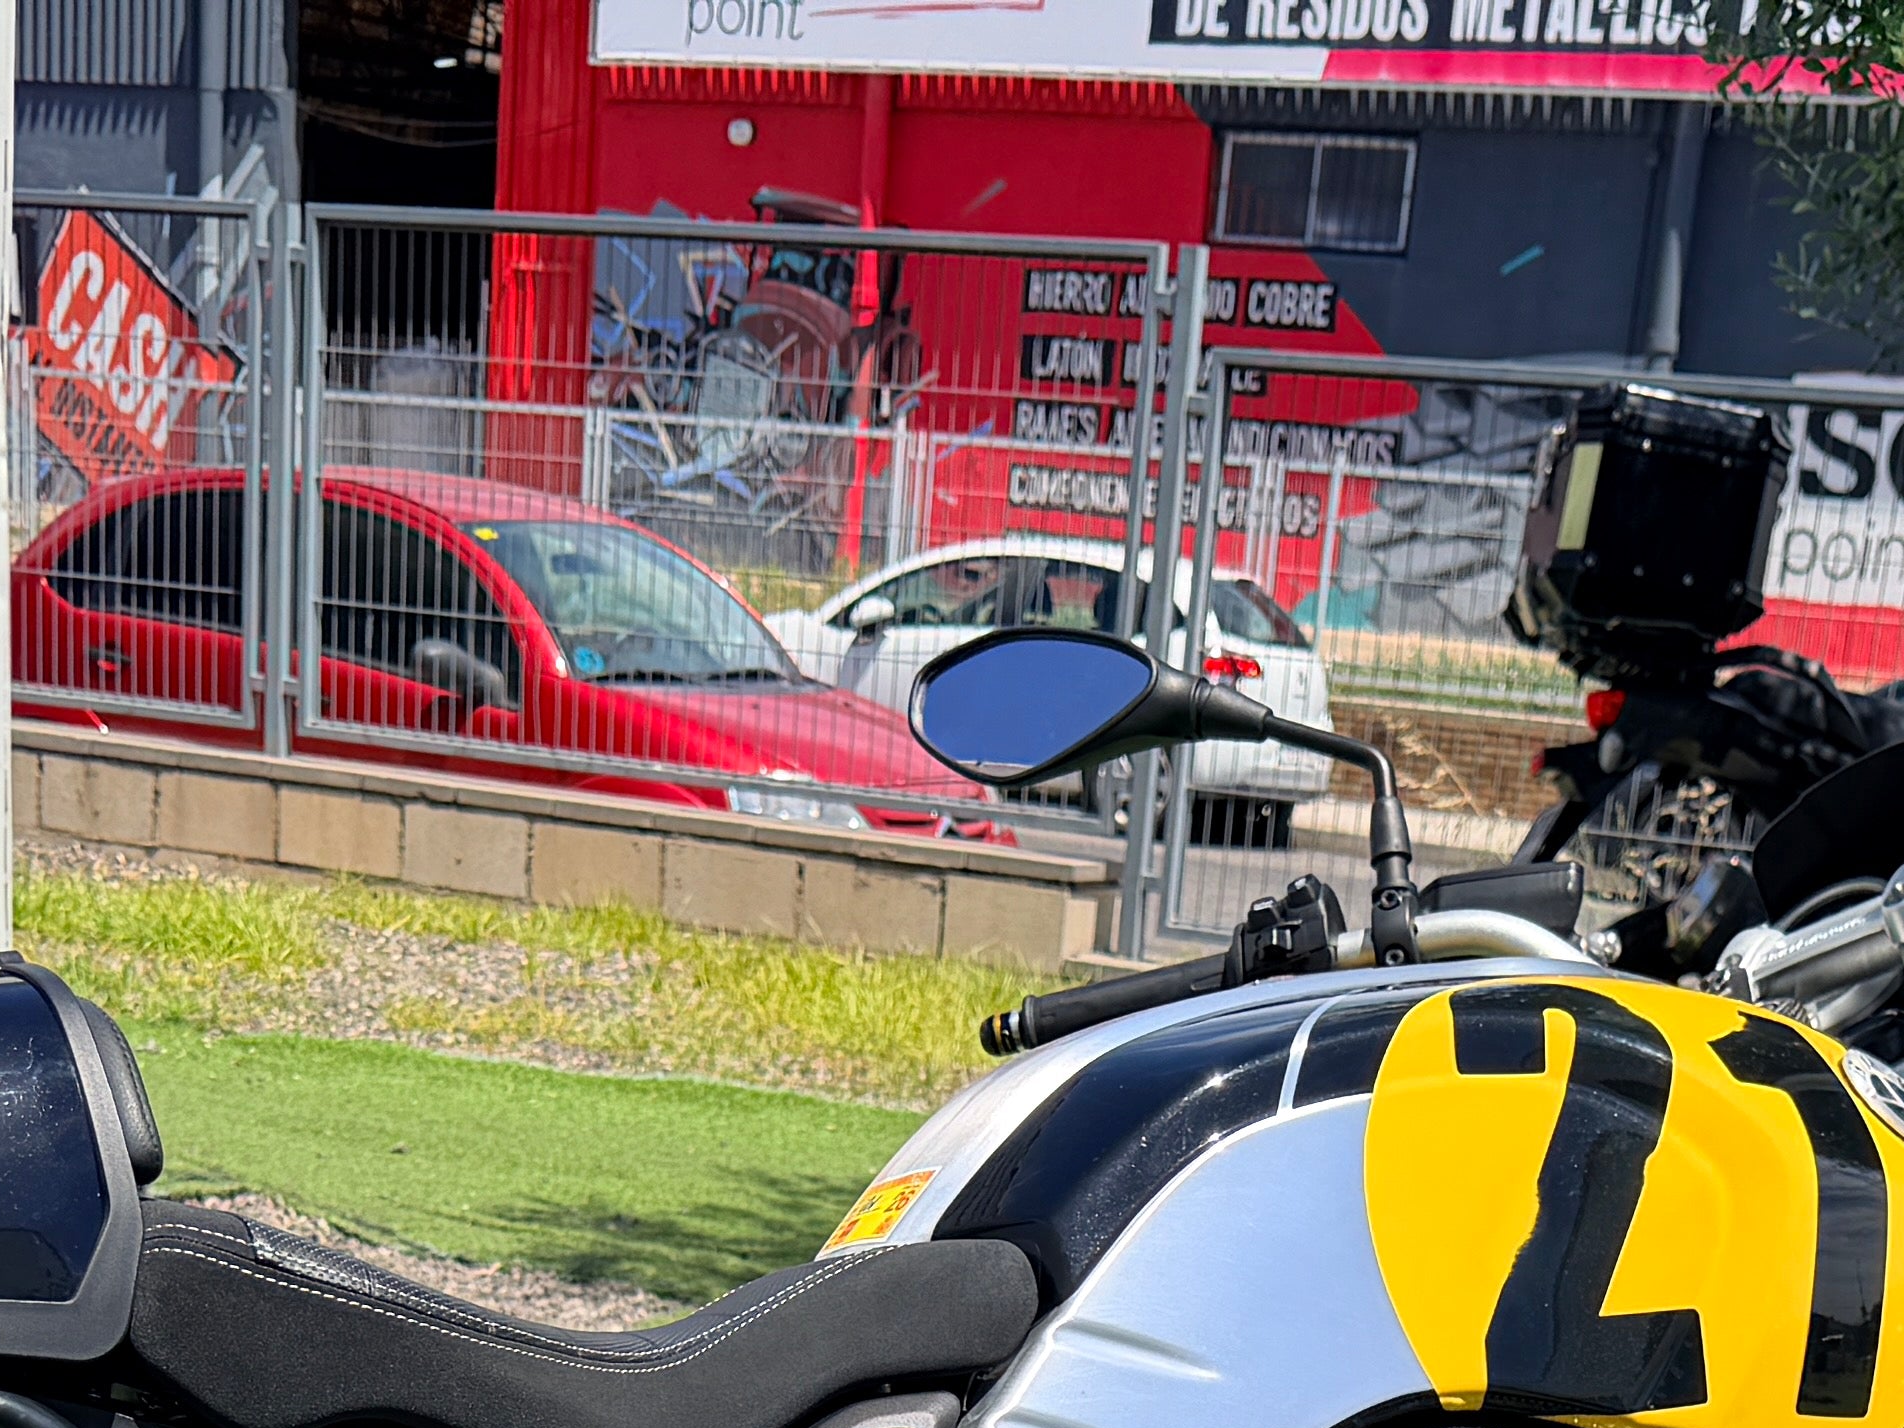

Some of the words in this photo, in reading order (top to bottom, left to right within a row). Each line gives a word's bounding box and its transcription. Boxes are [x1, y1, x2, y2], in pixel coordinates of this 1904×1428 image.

[48, 250, 196, 450] CASH
[1246, 280, 1334, 329] COBRE
[1445, 982, 1892, 1417] 21
